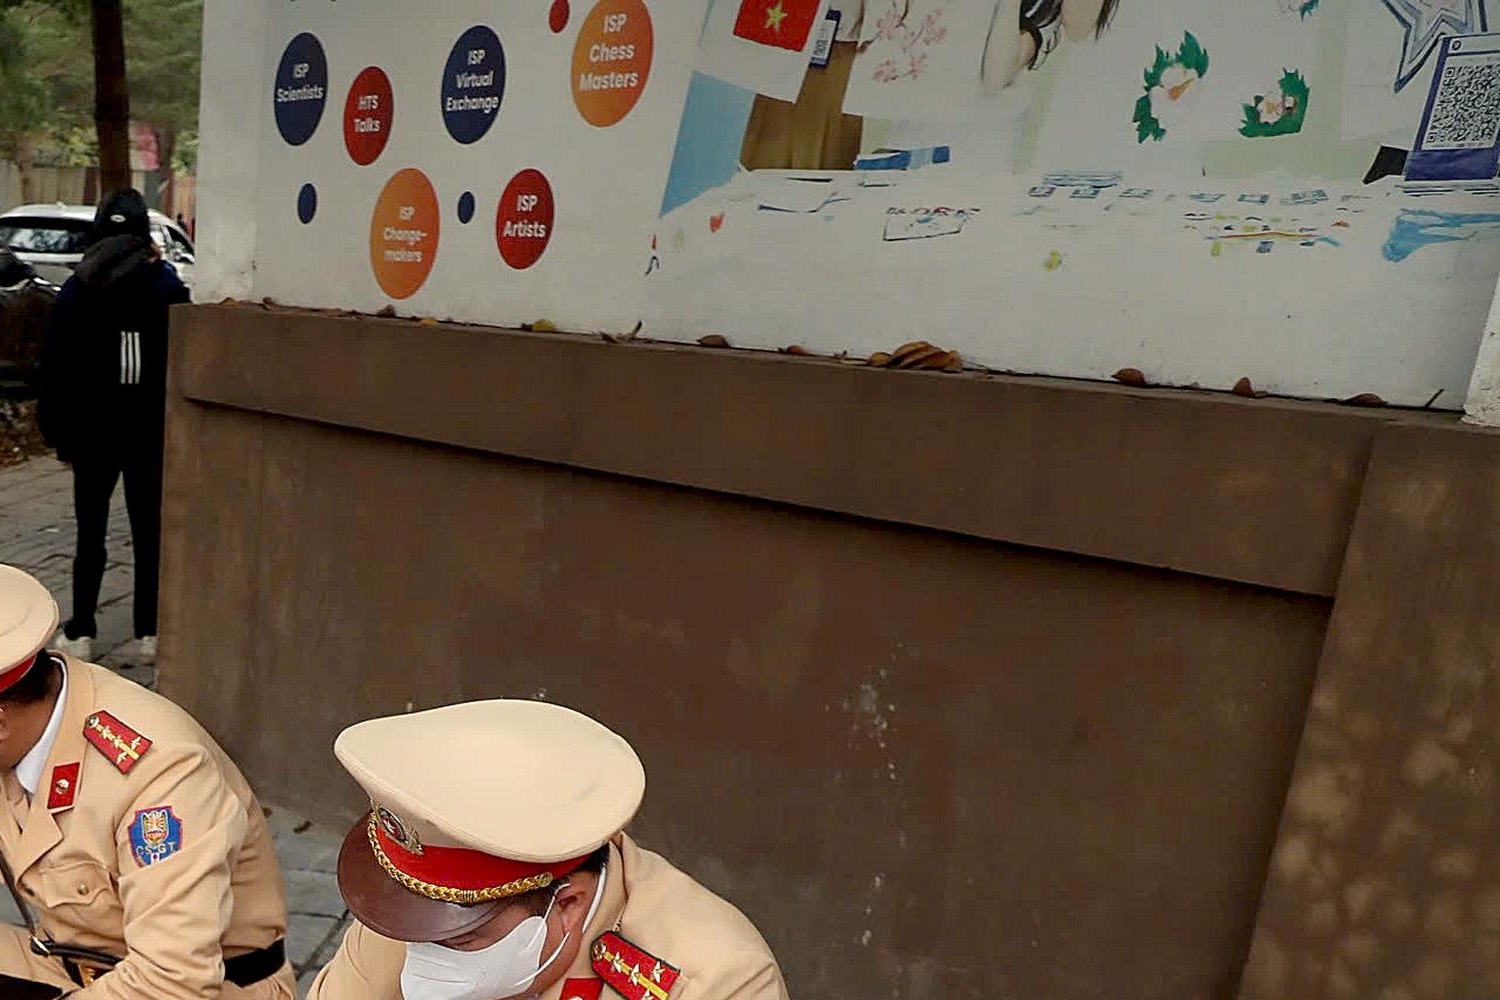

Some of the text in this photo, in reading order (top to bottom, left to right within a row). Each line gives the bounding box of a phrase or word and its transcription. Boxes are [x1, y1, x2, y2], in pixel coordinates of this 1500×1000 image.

[604, 14, 627, 34] ISP
[467, 50, 486, 65] ISP
[590, 44, 635, 62] Chess
[293, 63, 309, 79] ISP
[456, 71, 494, 88] Virtual
[580, 72, 639, 91] Masters
[277, 84, 324, 102] Scientists
[446, 96, 499, 113] Exchange
[354, 118, 380, 133] Talks
[516, 194, 538, 212] ISP
[399, 206, 415, 220] ISP
[384, 226, 427, 246] Change-
[503, 219, 546, 238] Artists
[384, 249, 422, 262] makers
